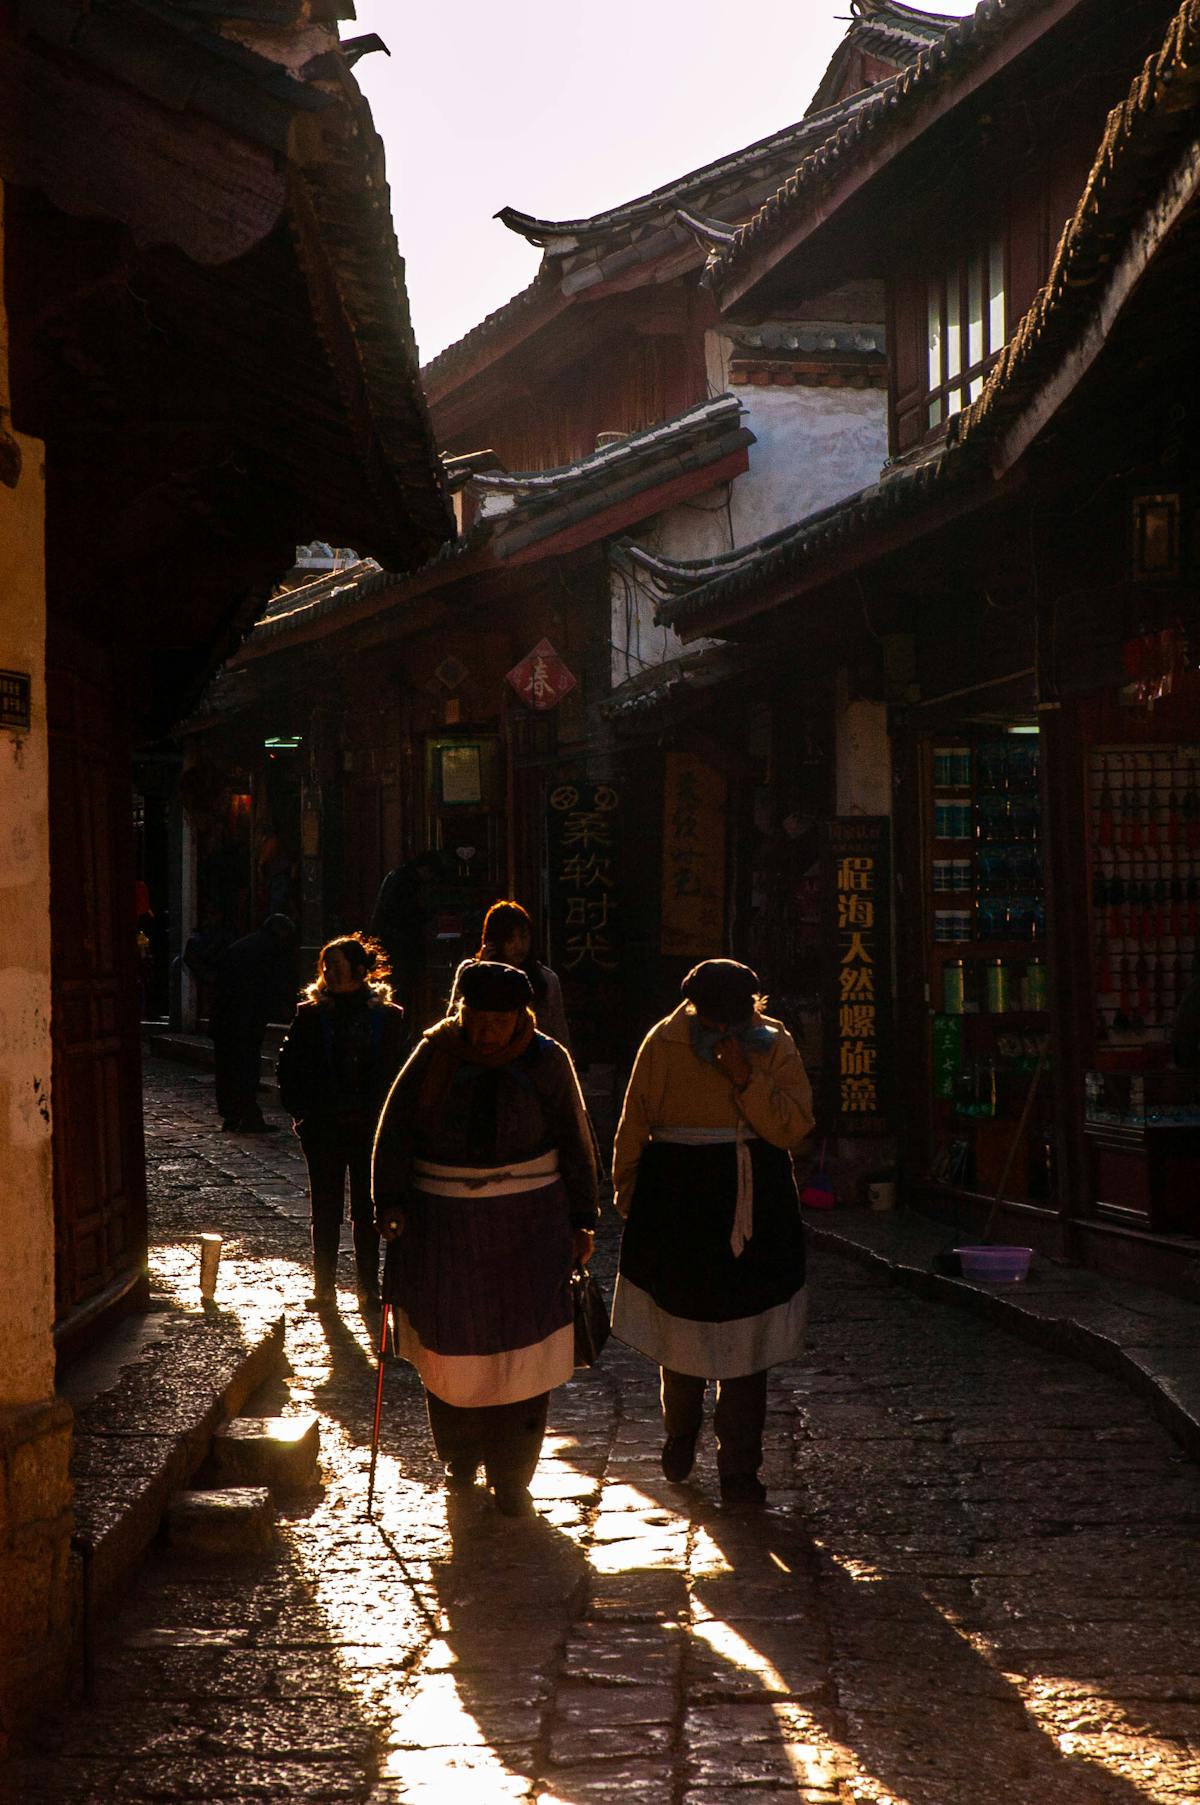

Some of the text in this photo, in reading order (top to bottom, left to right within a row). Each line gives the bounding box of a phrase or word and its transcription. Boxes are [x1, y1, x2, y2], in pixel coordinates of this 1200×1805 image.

[523, 656, 556, 699] 春
[559, 812, 618, 968] 柔软时光
[836, 856, 876, 1112] 程海天然螺旋藻
